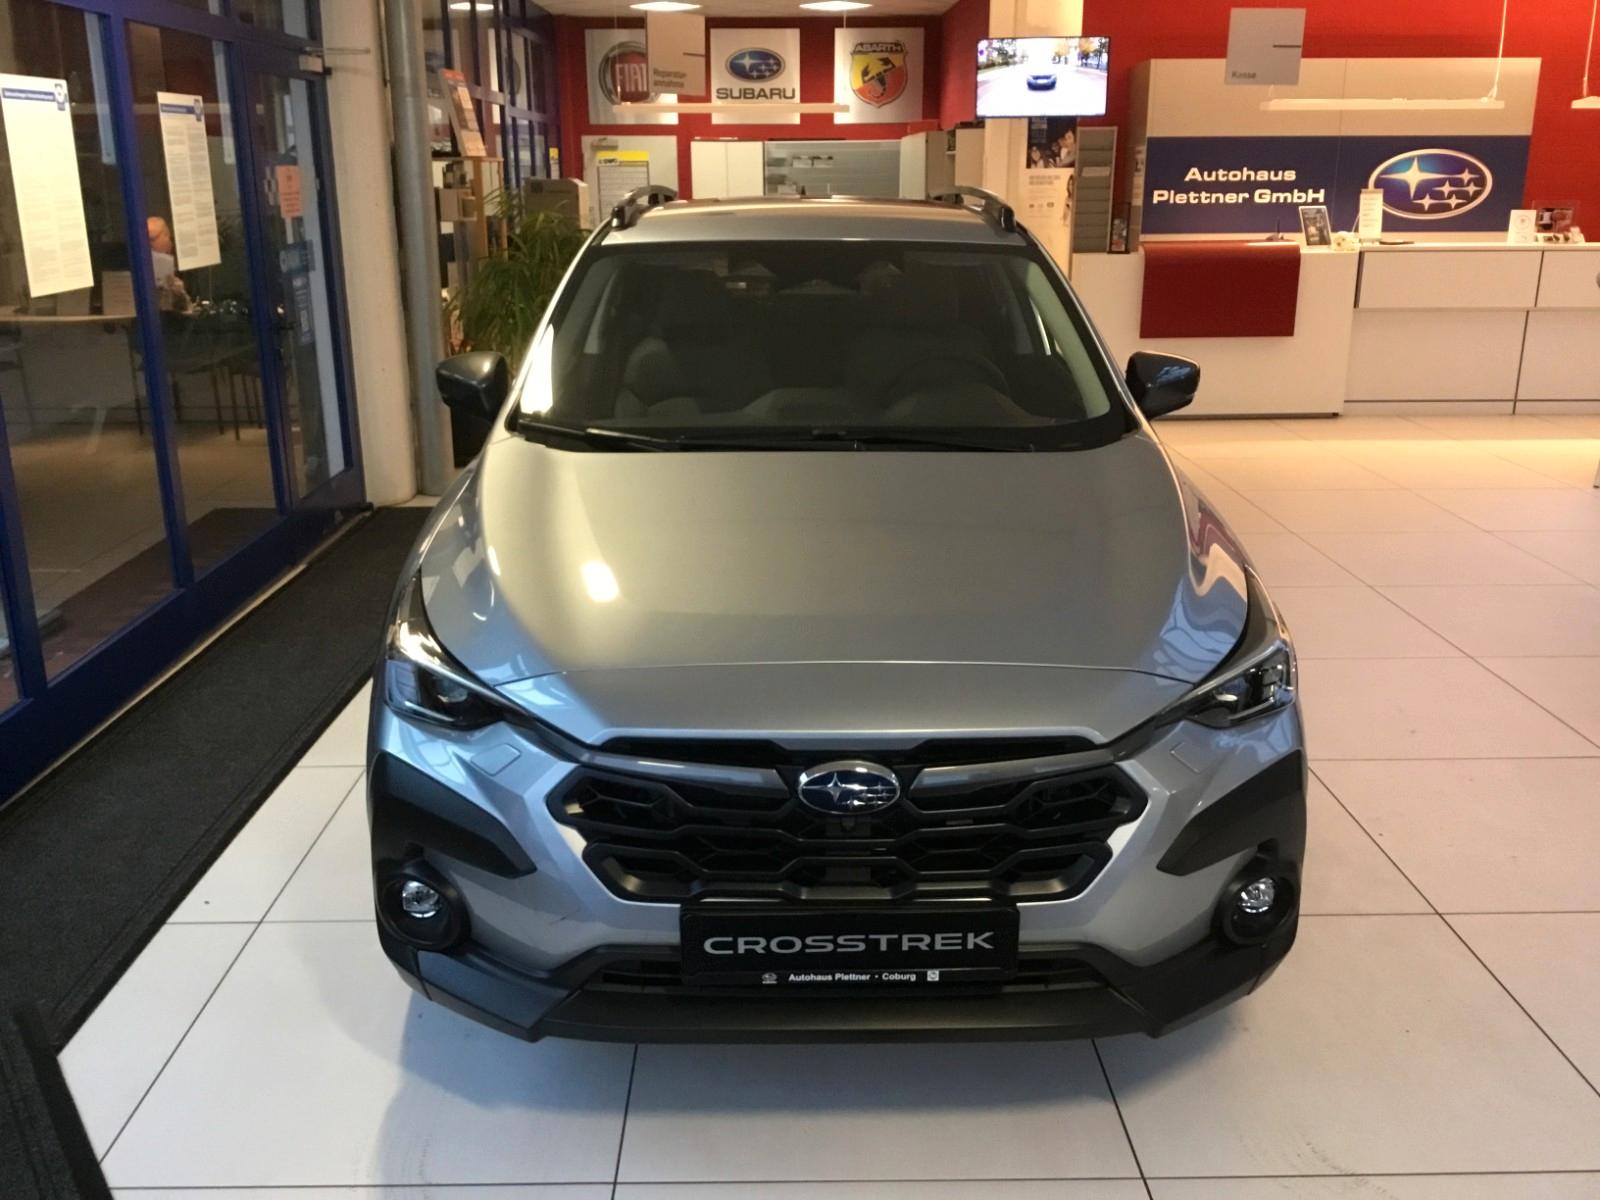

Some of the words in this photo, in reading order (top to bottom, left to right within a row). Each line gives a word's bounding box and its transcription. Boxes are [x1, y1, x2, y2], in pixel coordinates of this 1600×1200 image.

[856, 43, 902, 52] ABARTH
[716, 87, 796, 100] SUBARU
[1184, 166, 1297, 181] Autohaus
[1152, 188, 1250, 205] Plettner
[1254, 188, 1326, 204] GmbH
[703, 931, 995, 956] CROSSTREK
[788, 973, 833, 982] Autohaus
[834, 972, 871, 981] Plettner
[882, 972, 917, 982] Coburg
